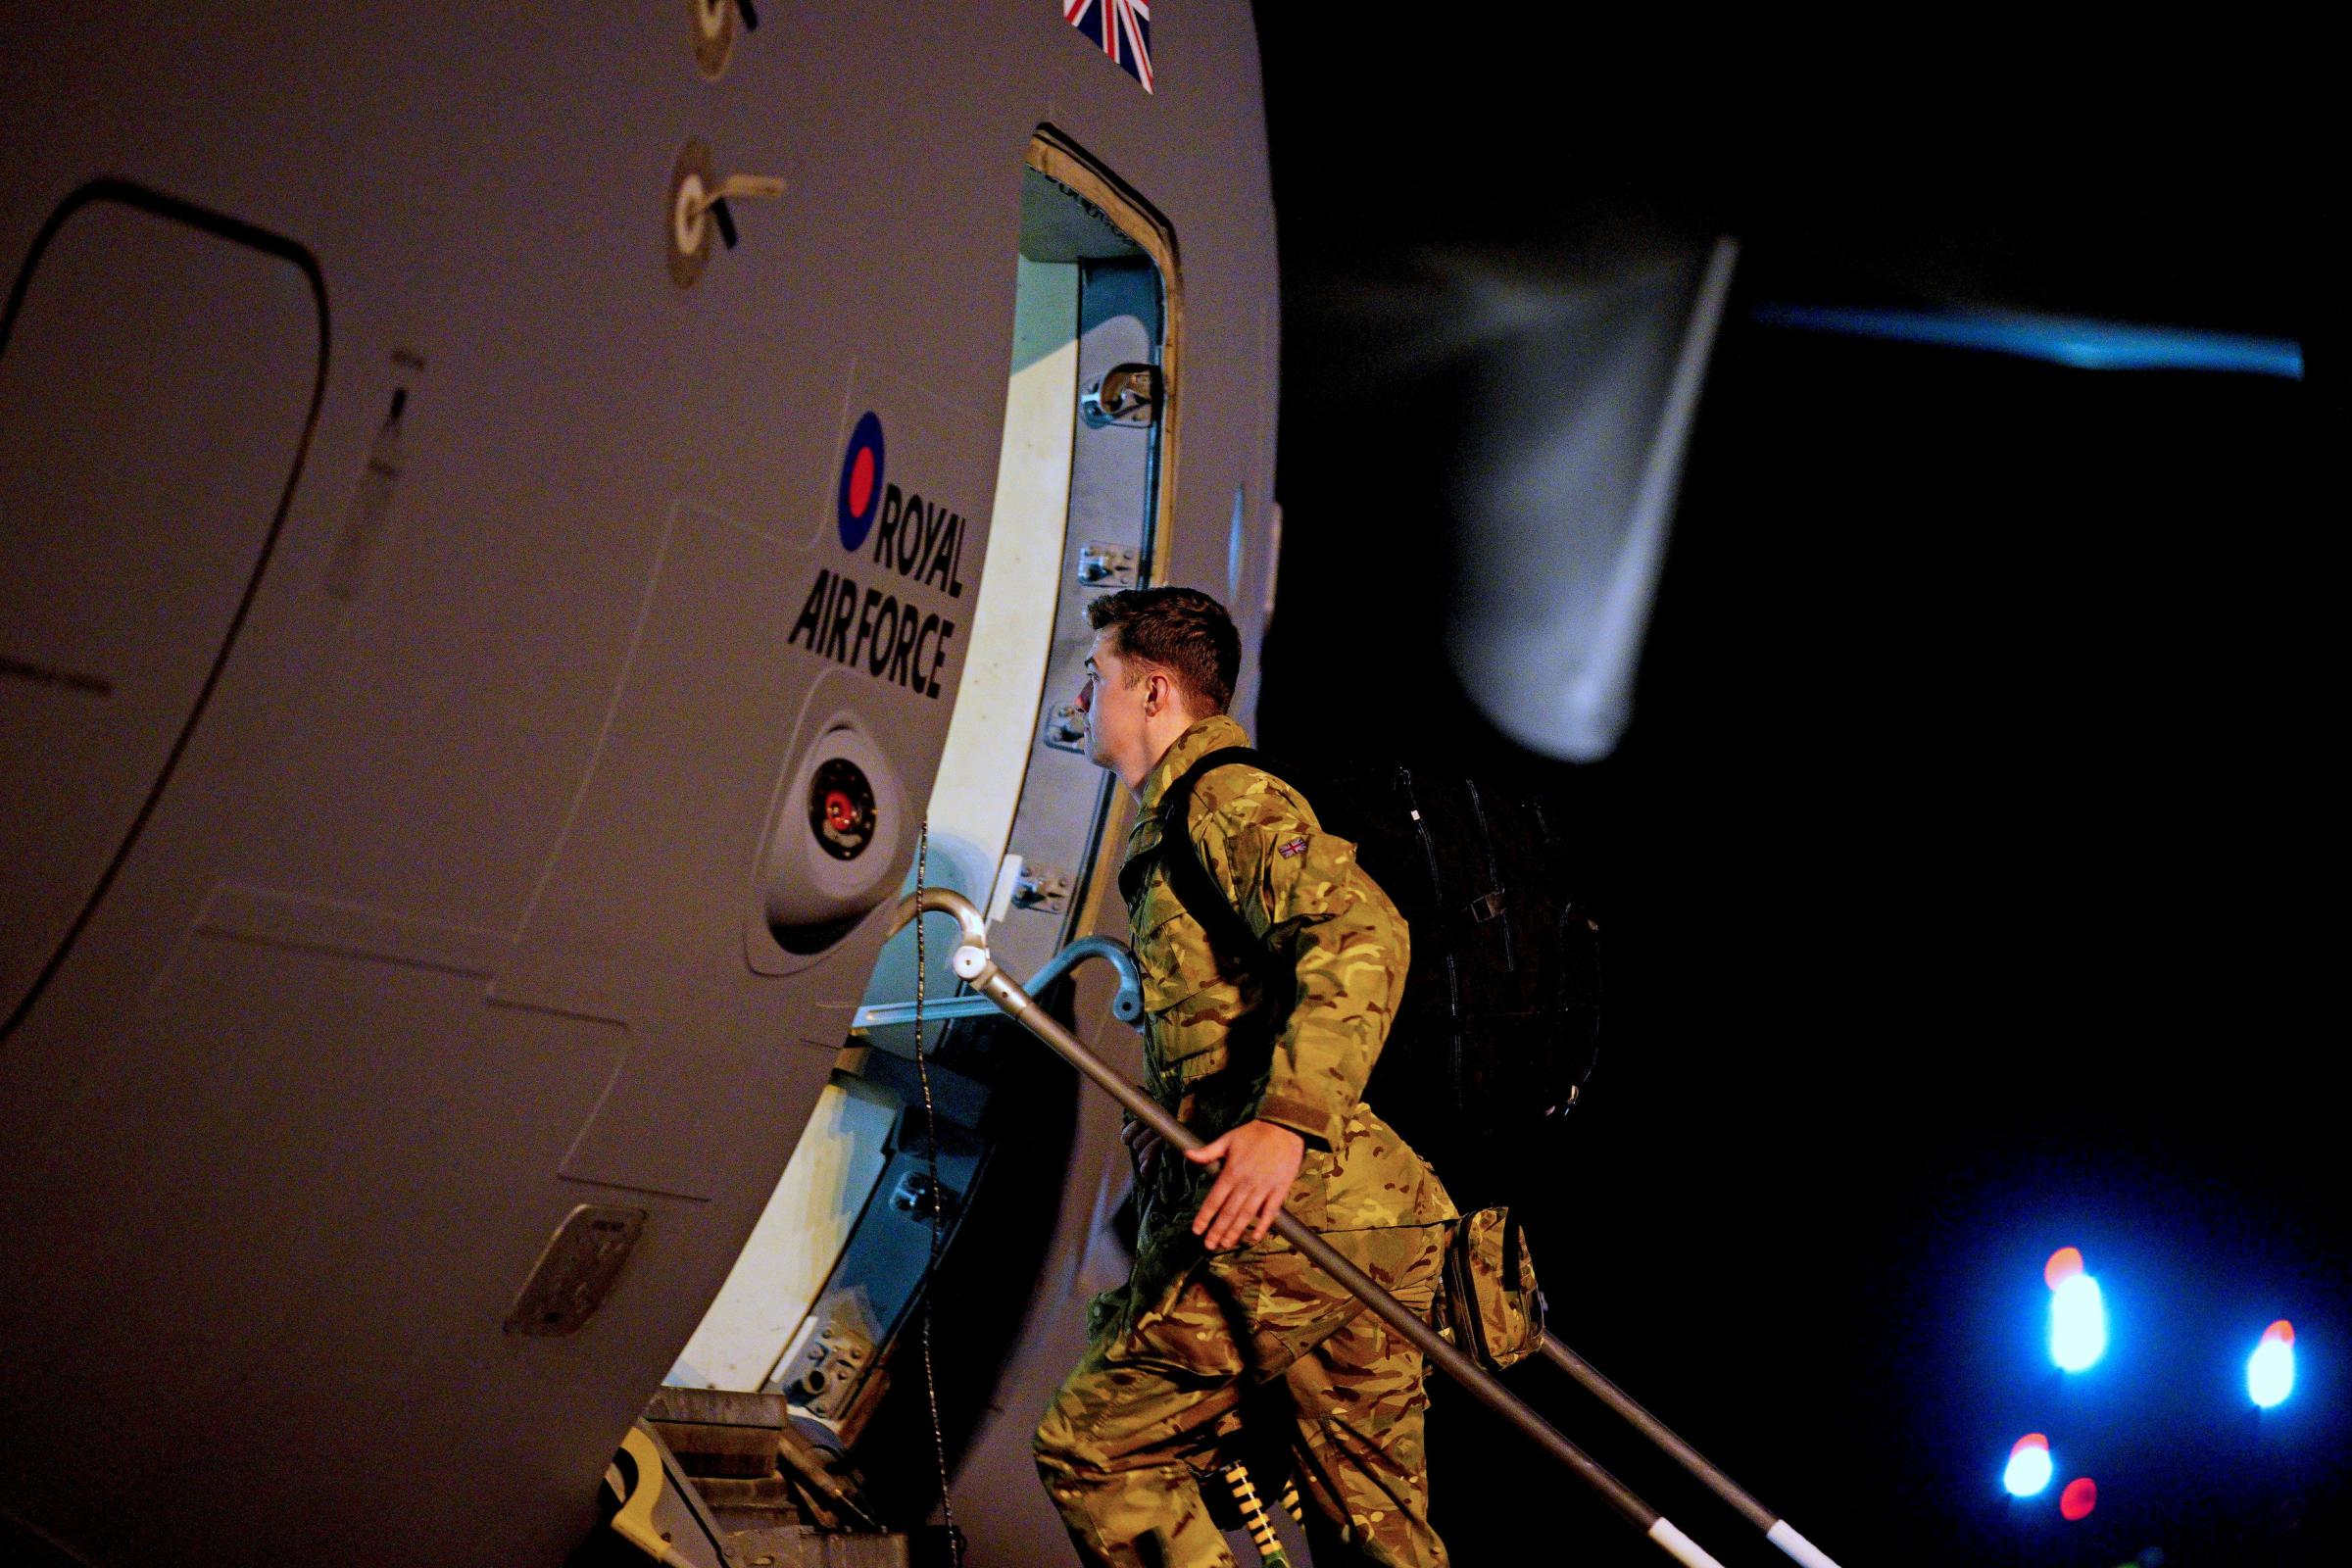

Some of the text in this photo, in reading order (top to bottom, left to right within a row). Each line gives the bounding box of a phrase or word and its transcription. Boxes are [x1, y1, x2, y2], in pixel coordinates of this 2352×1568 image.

[874, 484, 965, 598] ROYAL
[788, 569, 955, 699] AIR FORCE
